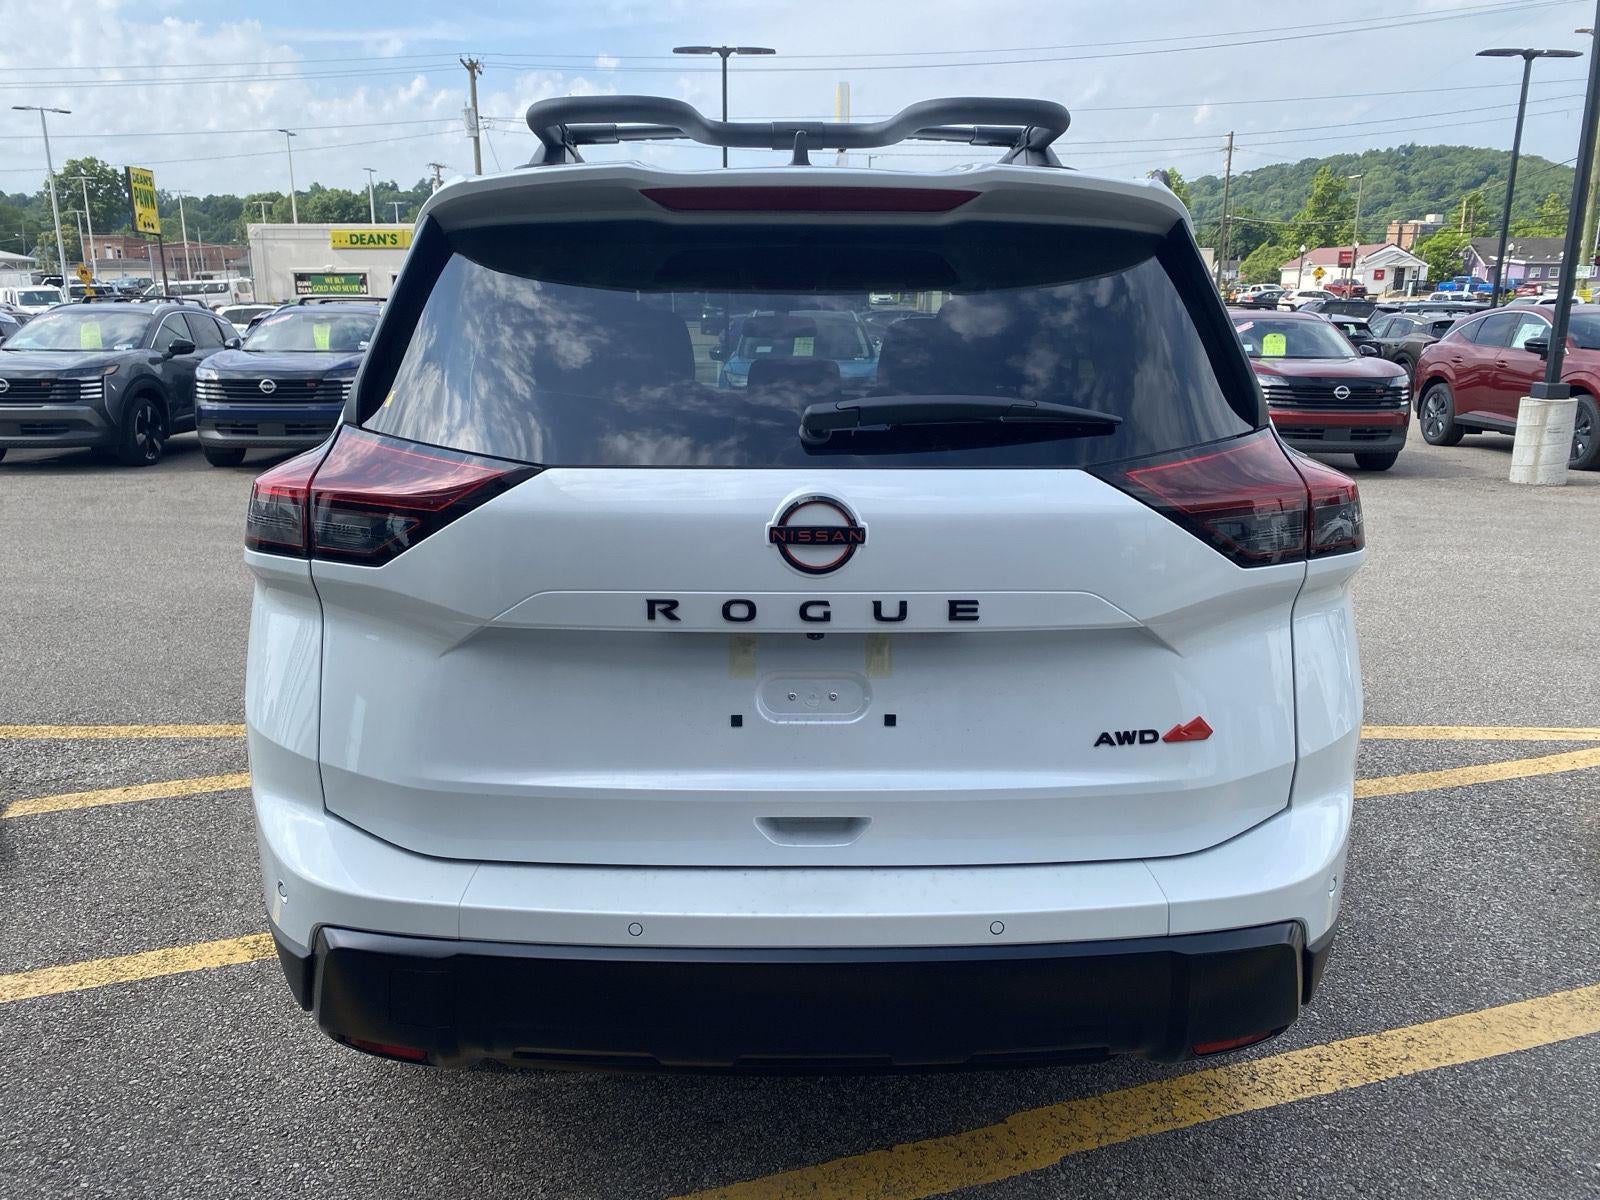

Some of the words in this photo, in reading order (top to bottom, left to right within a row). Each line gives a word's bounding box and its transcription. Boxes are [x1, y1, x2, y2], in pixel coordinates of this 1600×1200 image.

[132, 173, 153, 187] DEAN'S
[134, 186, 155, 210] PAWN
[334, 276, 345, 284] BUY
[312, 284, 329, 292] GOLD
[329, 284, 342, 292] AND
[342, 284, 359, 292] SILVER
[771, 529, 864, 543] NISSAN
[645, 598, 981, 623] ROGUE
[1093, 728, 1160, 747] AWD
